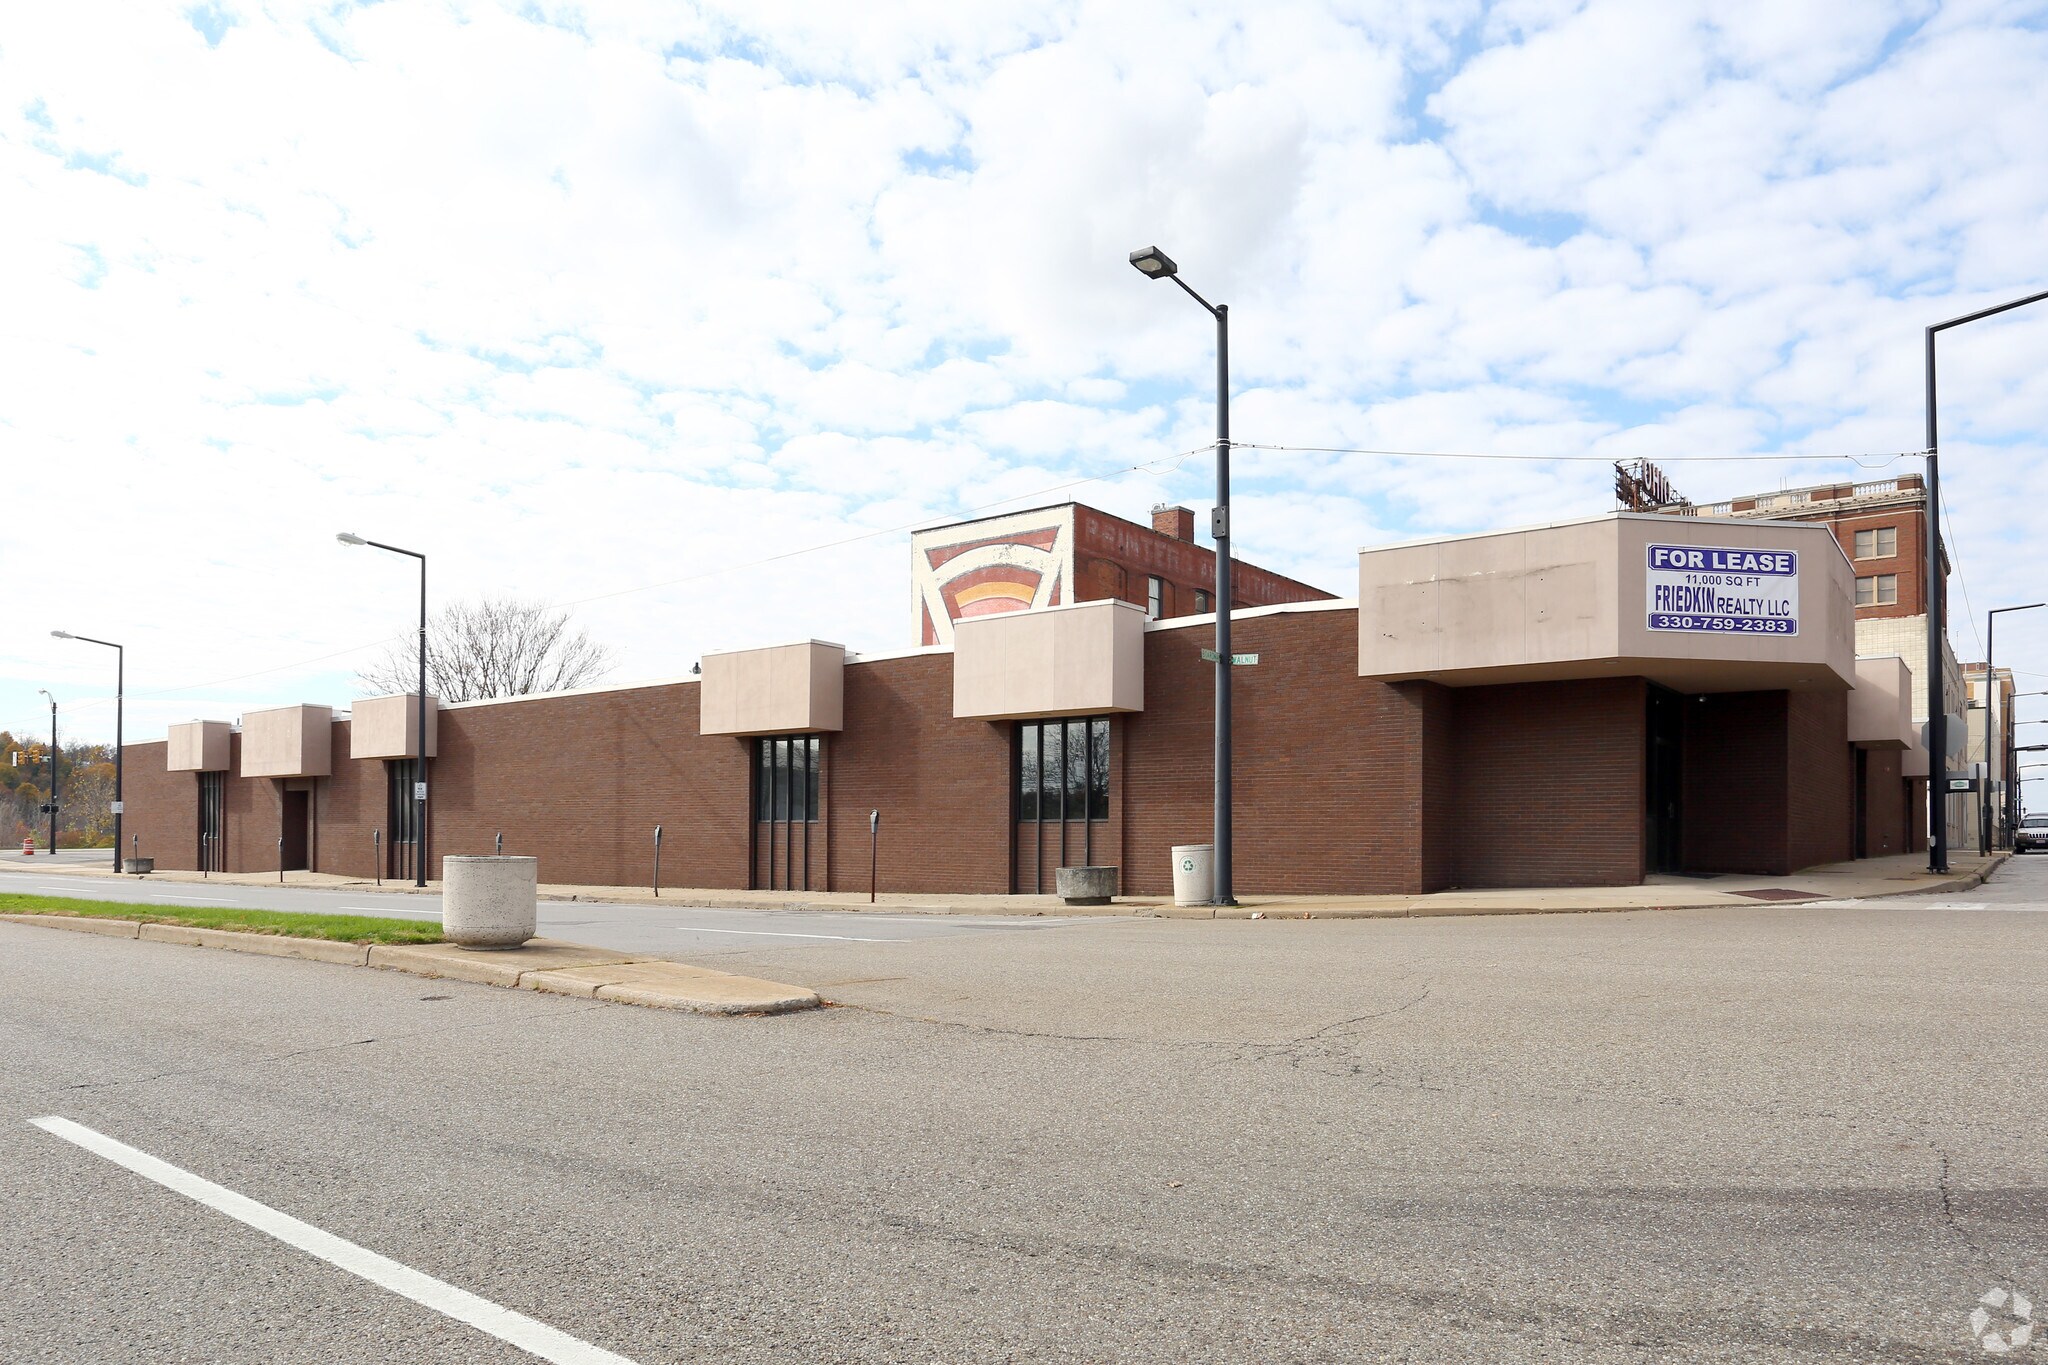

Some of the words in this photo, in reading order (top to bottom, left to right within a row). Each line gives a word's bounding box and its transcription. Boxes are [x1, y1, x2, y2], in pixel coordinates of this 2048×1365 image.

[1641, 459, 1670, 504] OHIO
[1655, 548, 1704, 568] FOR
[1712, 552, 1790, 572] LEASE
[1685, 574, 1721, 586] 11,000
[1725, 576, 1743, 587] SQ
[1746, 577, 1761, 587] FT
[1655, 585, 1715, 613] FRIEDKIN
[1717, 597, 1764, 615] REALTY
[1768, 600, 1789, 616] LLC
[1658, 616, 1788, 632] 330-759-2383
